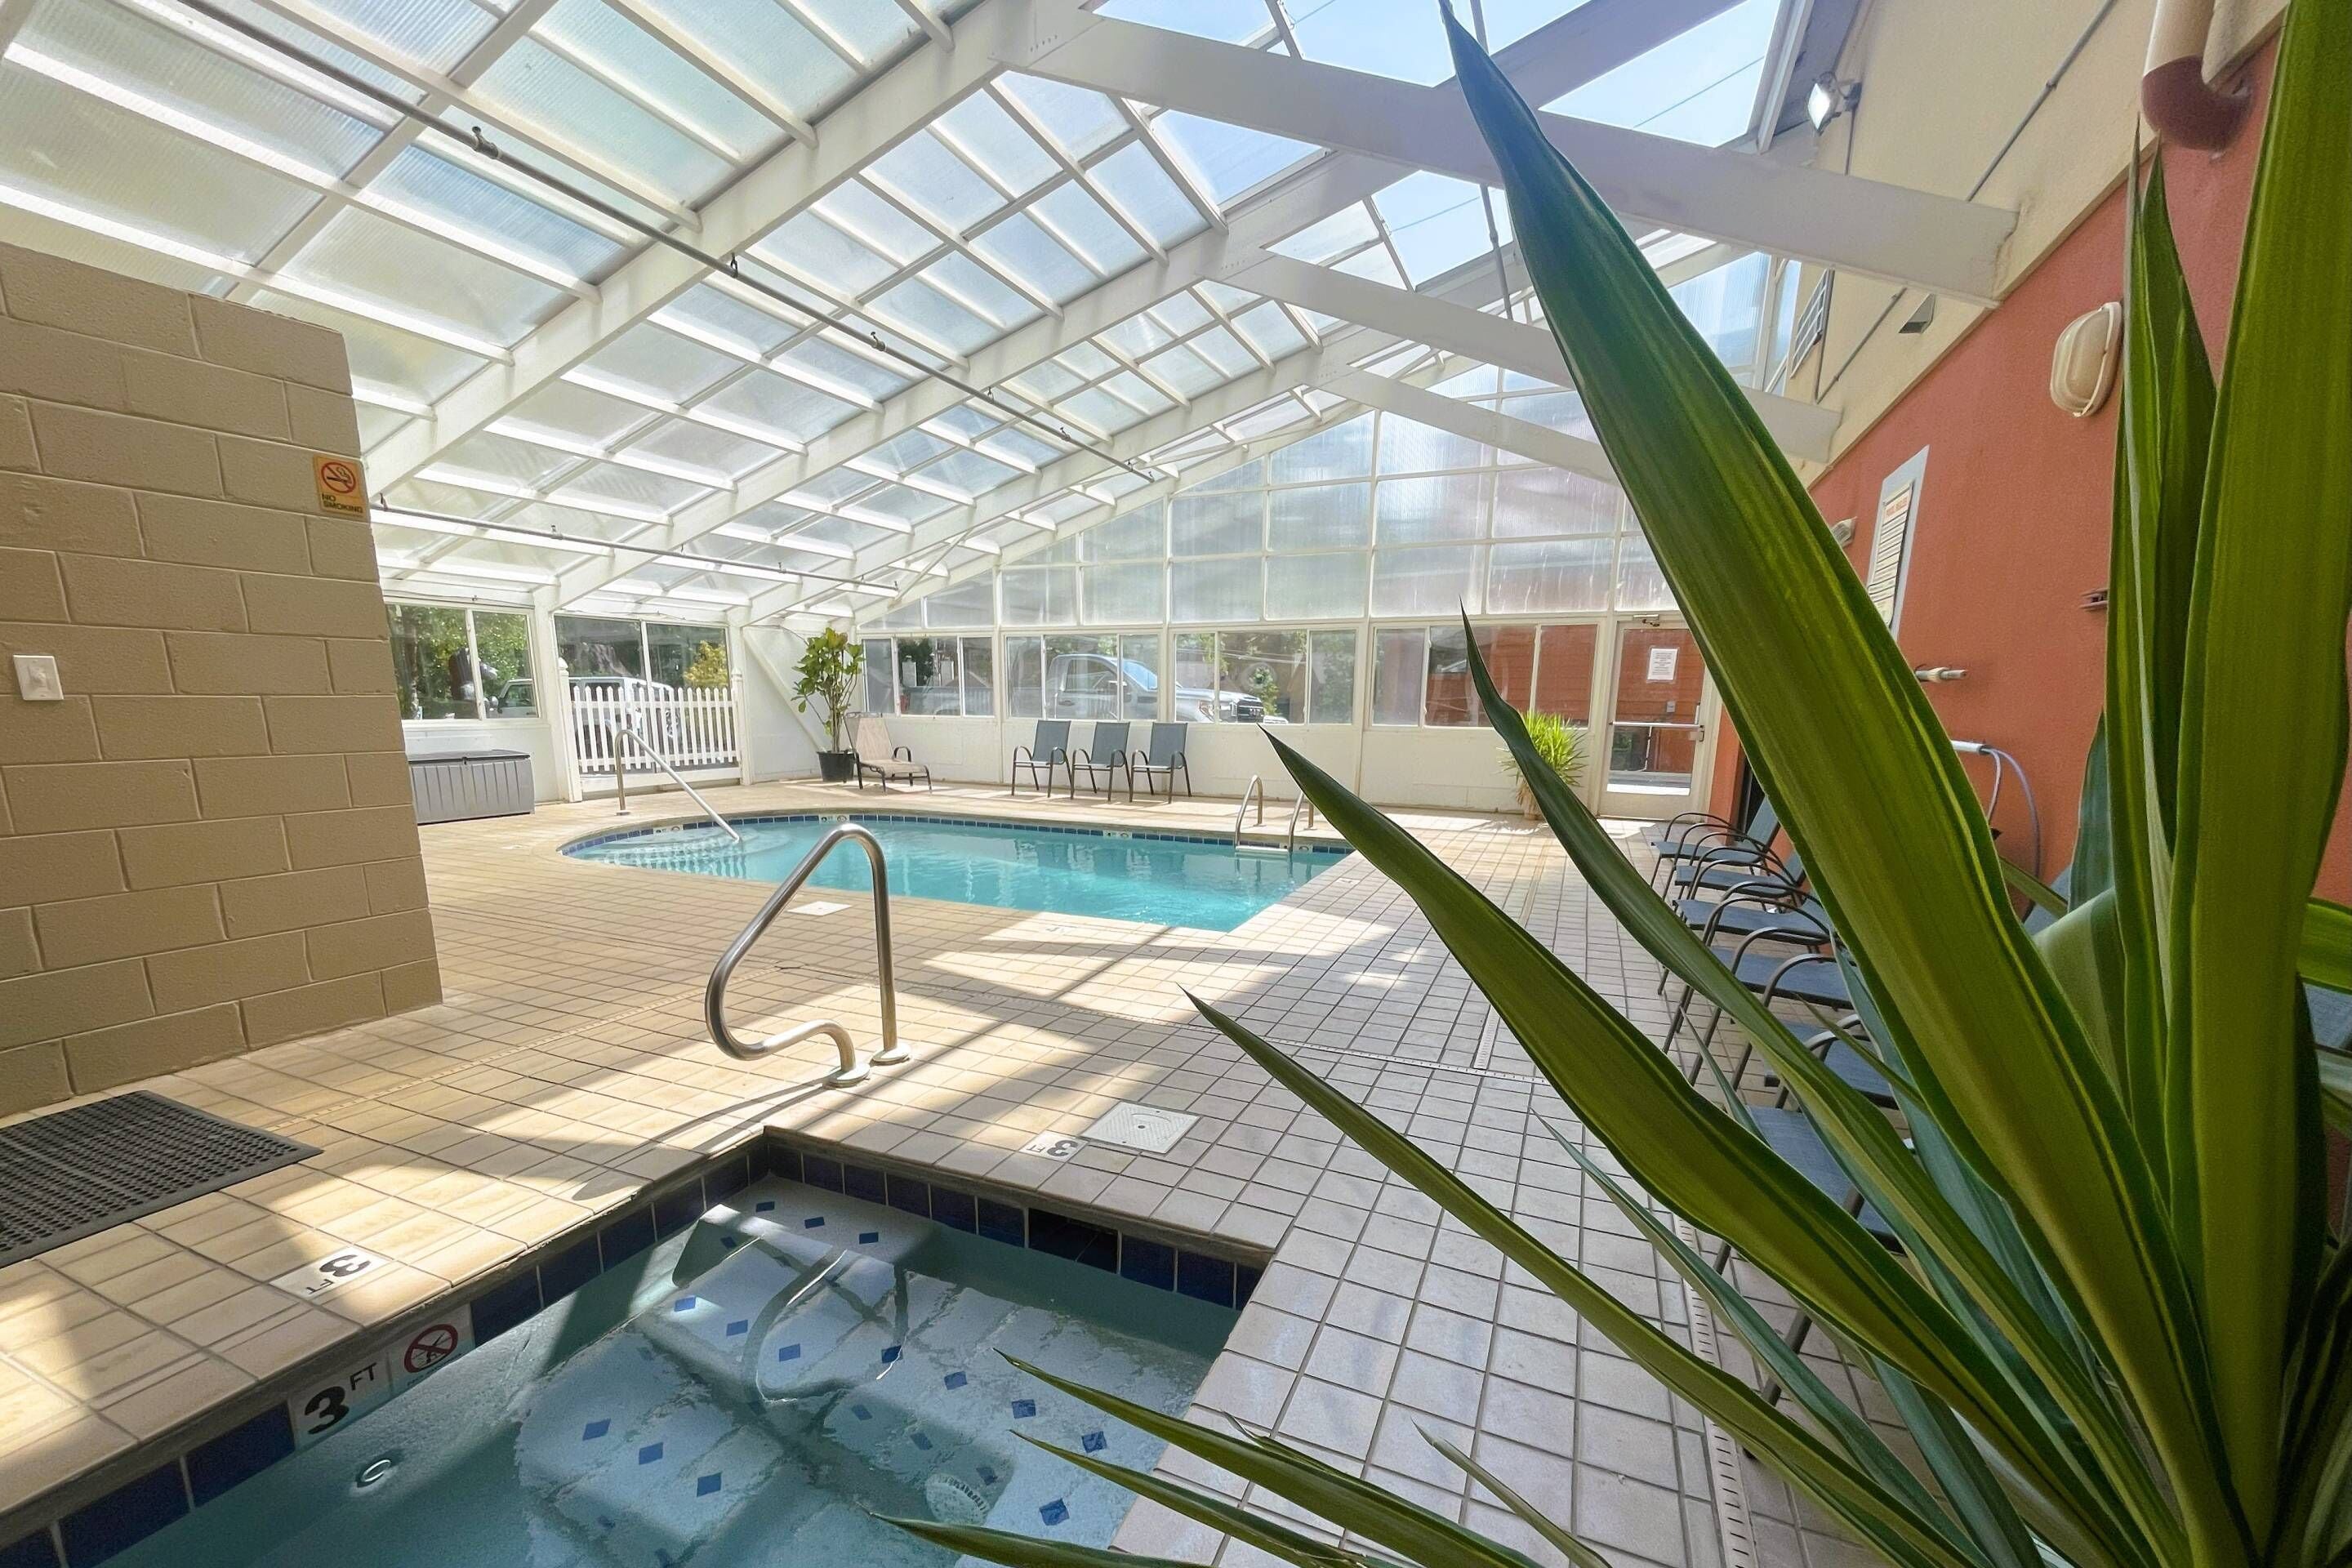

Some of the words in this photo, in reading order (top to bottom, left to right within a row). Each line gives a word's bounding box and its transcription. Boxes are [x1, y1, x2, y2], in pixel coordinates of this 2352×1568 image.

[322, 492, 336, 501] NO
[323, 500, 363, 513] SMOKING
[1026, 1145, 1046, 1153] FT
[1046, 1140, 1079, 1157] 3
[318, 1254, 372, 1277] 3
[306, 1278, 335, 1295] FT
[304, 1386, 350, 1434] 3
[350, 1361, 378, 1391] FT
